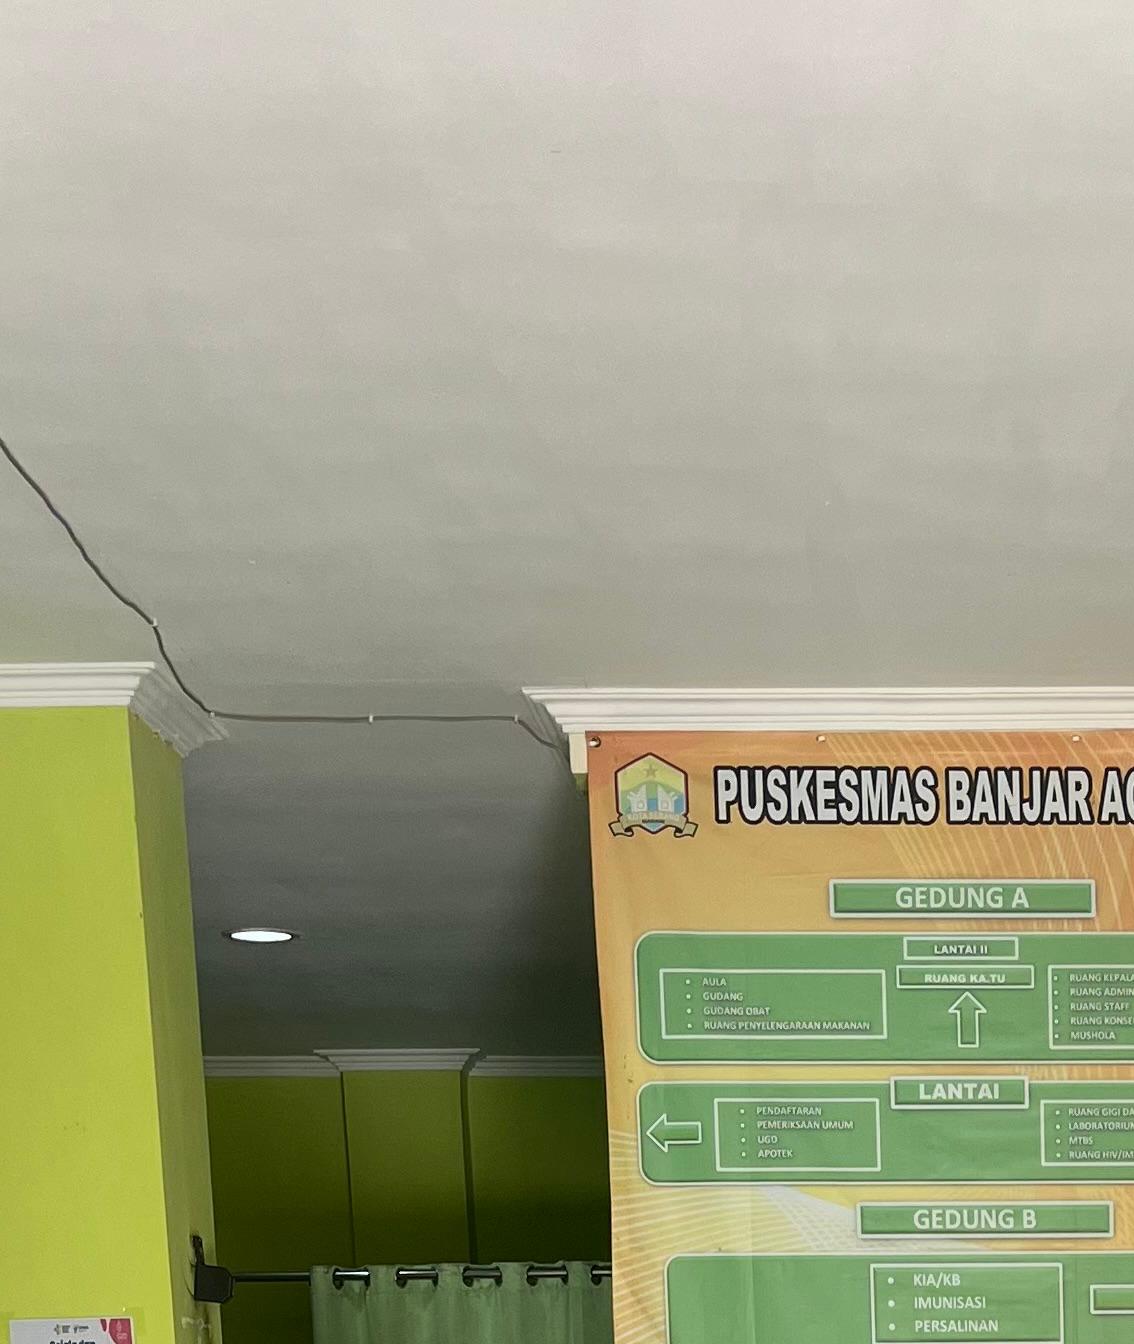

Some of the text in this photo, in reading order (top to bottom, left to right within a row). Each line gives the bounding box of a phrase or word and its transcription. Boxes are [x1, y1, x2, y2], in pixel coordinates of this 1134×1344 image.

[714, 766, 939, 825] PUSKESMAS
[945, 766, 1095, 825] BANJAR
[895, 886, 1030, 909] GEDUNG A
[934, 945, 977, 955] LANTAI
[702, 978, 727, 986] AULA
[924, 974, 1006, 984] RUANG KA.TU
[1070, 973, 1101, 982] RUANG
[703, 992, 744, 1001] GUDANG
[1070, 988, 1101, 996] RUANG
[1070, 1002, 1101, 1011] RUANG
[703, 1007, 770, 1016] GUDANG OBAT
[704, 1021, 736, 1030] RUANG
[823, 1021, 870, 1030] MAKANAN
[1070, 1017, 1101, 1025] RUANG
[1070, 1032, 1116, 1040] MUSHOLA
[919, 1083, 1000, 1100] LANTAI
[756, 1107, 822, 1116] PENDAFTARAN
[1068, 1108, 1100, 1116] RUANG
[1101, 1108, 1121, 1116] GIGI
[757, 1121, 854, 1129] PEMERIKSAAN UMUM
[757, 1149, 793, 1158] APOTEK
[1069, 1151, 1100, 1159] RUANG
[913, 1208, 1037, 1230] GEDUNG B
[913, 1272, 961, 1288] KIA/KB
[914, 1296, 987, 1310] IMUNISASI
[914, 1320, 999, 1333] PERSALINAN
